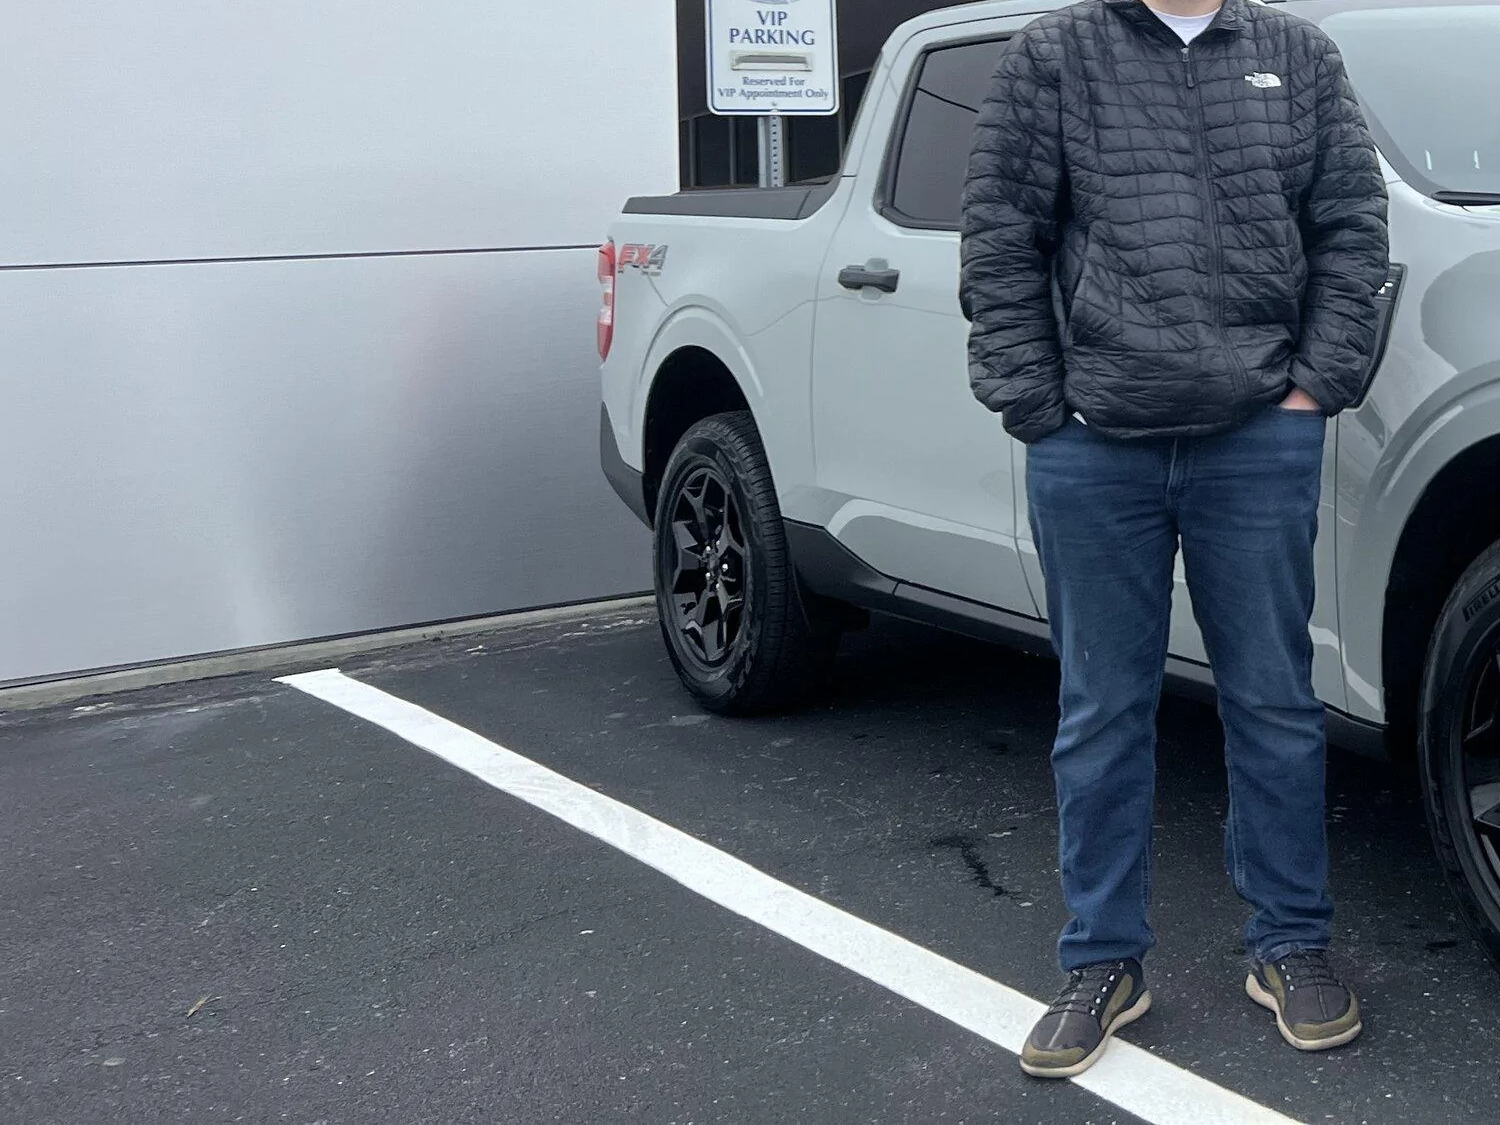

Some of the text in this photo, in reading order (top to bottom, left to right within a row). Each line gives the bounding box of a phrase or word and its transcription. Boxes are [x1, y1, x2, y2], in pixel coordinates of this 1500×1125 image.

[756, 10, 788, 26] VIP
[728, 28, 815, 46] PARKING
[742, 76, 806, 86] Reserved For
[718, 88, 829, 100] VIP Appointment Only
[618, 243, 669, 274] FX4
